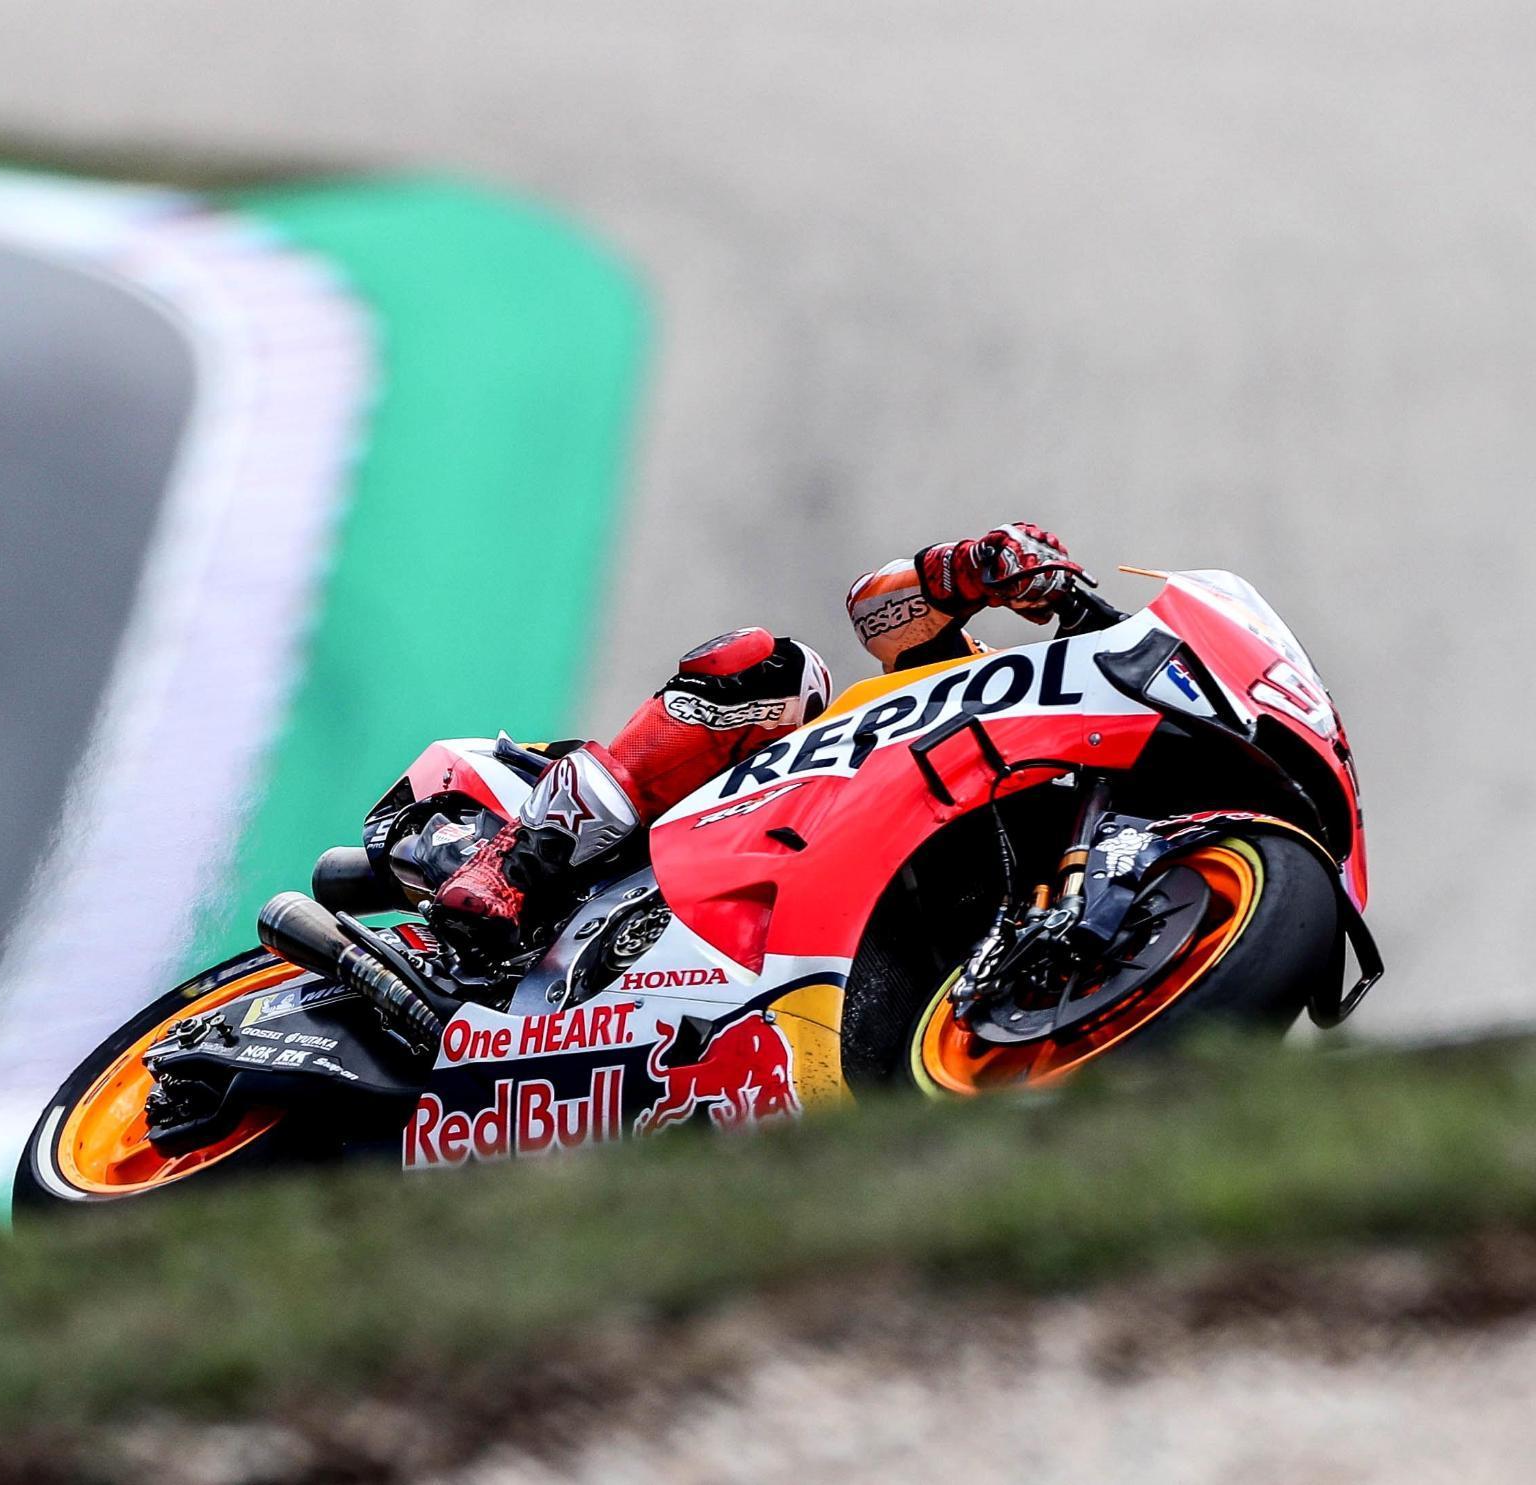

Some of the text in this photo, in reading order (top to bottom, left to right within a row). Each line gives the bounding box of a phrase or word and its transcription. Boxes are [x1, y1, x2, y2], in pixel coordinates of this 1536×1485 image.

[854, 596, 930, 642] nestars
[668, 697, 786, 728] alpinestars
[718, 638, 1084, 799] REPSOL
[620, 968, 729, 991] HONDA
[241, 1027, 285, 1040] GOSHI
[294, 1034, 339, 1049] YUTAKA
[442, 1002, 636, 1063] One HEART.
[240, 1045, 278, 1060] NGK
[274, 1049, 313, 1064] RK
[404, 1065, 625, 1168] Red Bull
